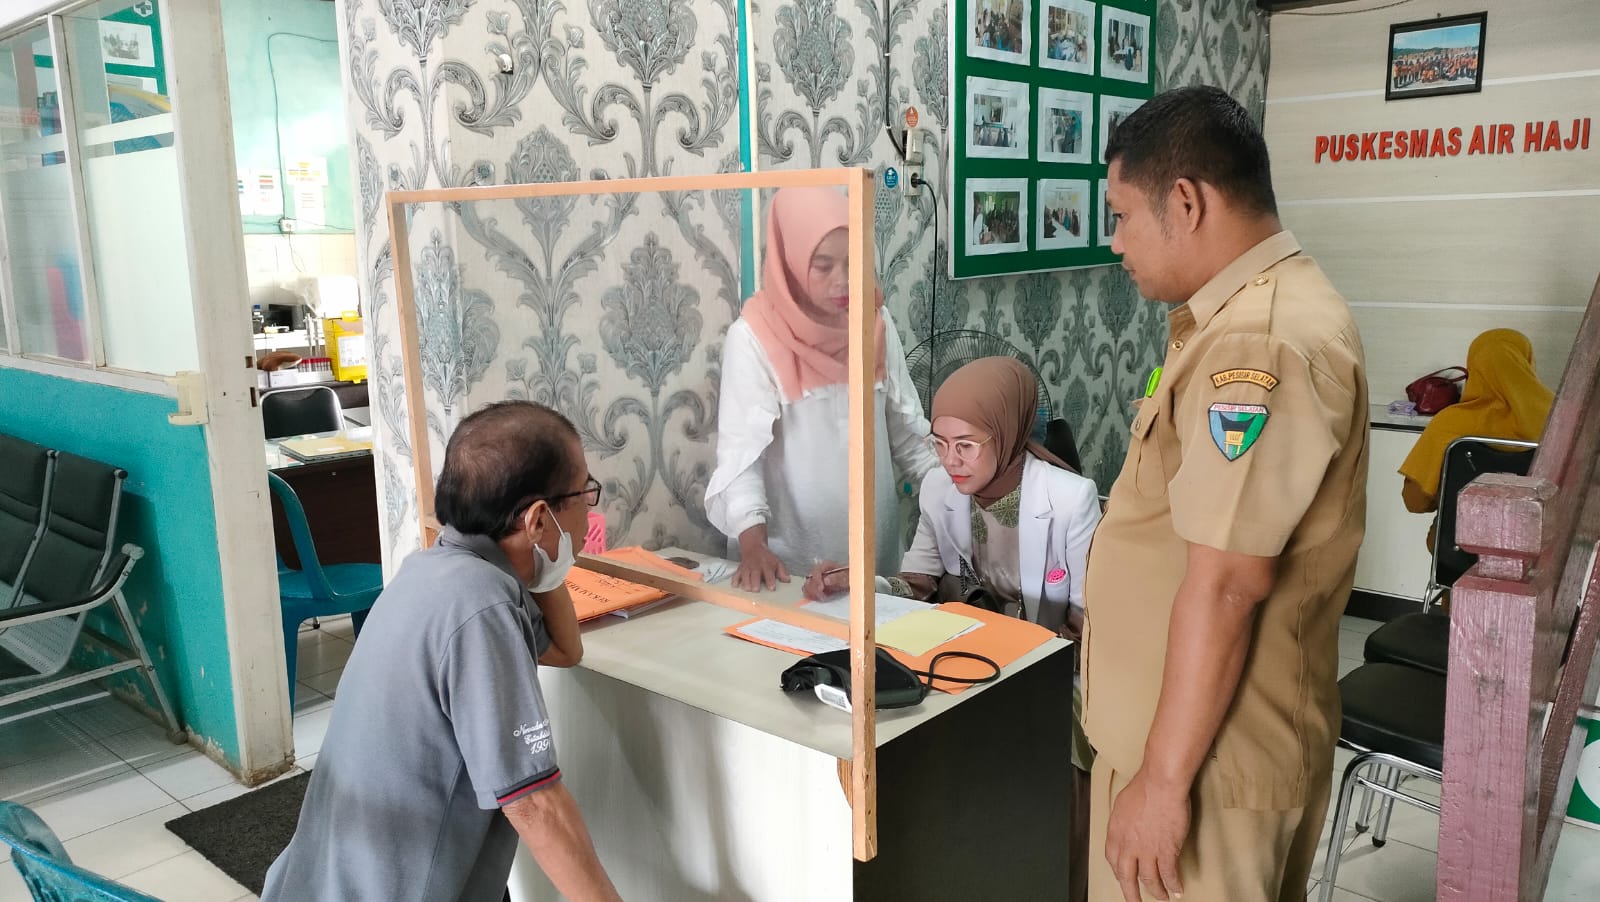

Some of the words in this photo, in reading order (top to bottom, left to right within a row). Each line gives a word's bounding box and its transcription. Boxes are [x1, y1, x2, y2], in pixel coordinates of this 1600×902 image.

[1314, 127, 1462, 163] PUSKESMAS
[1468, 123, 1515, 155] AIR
[1523, 118, 1591, 153] HAJI
